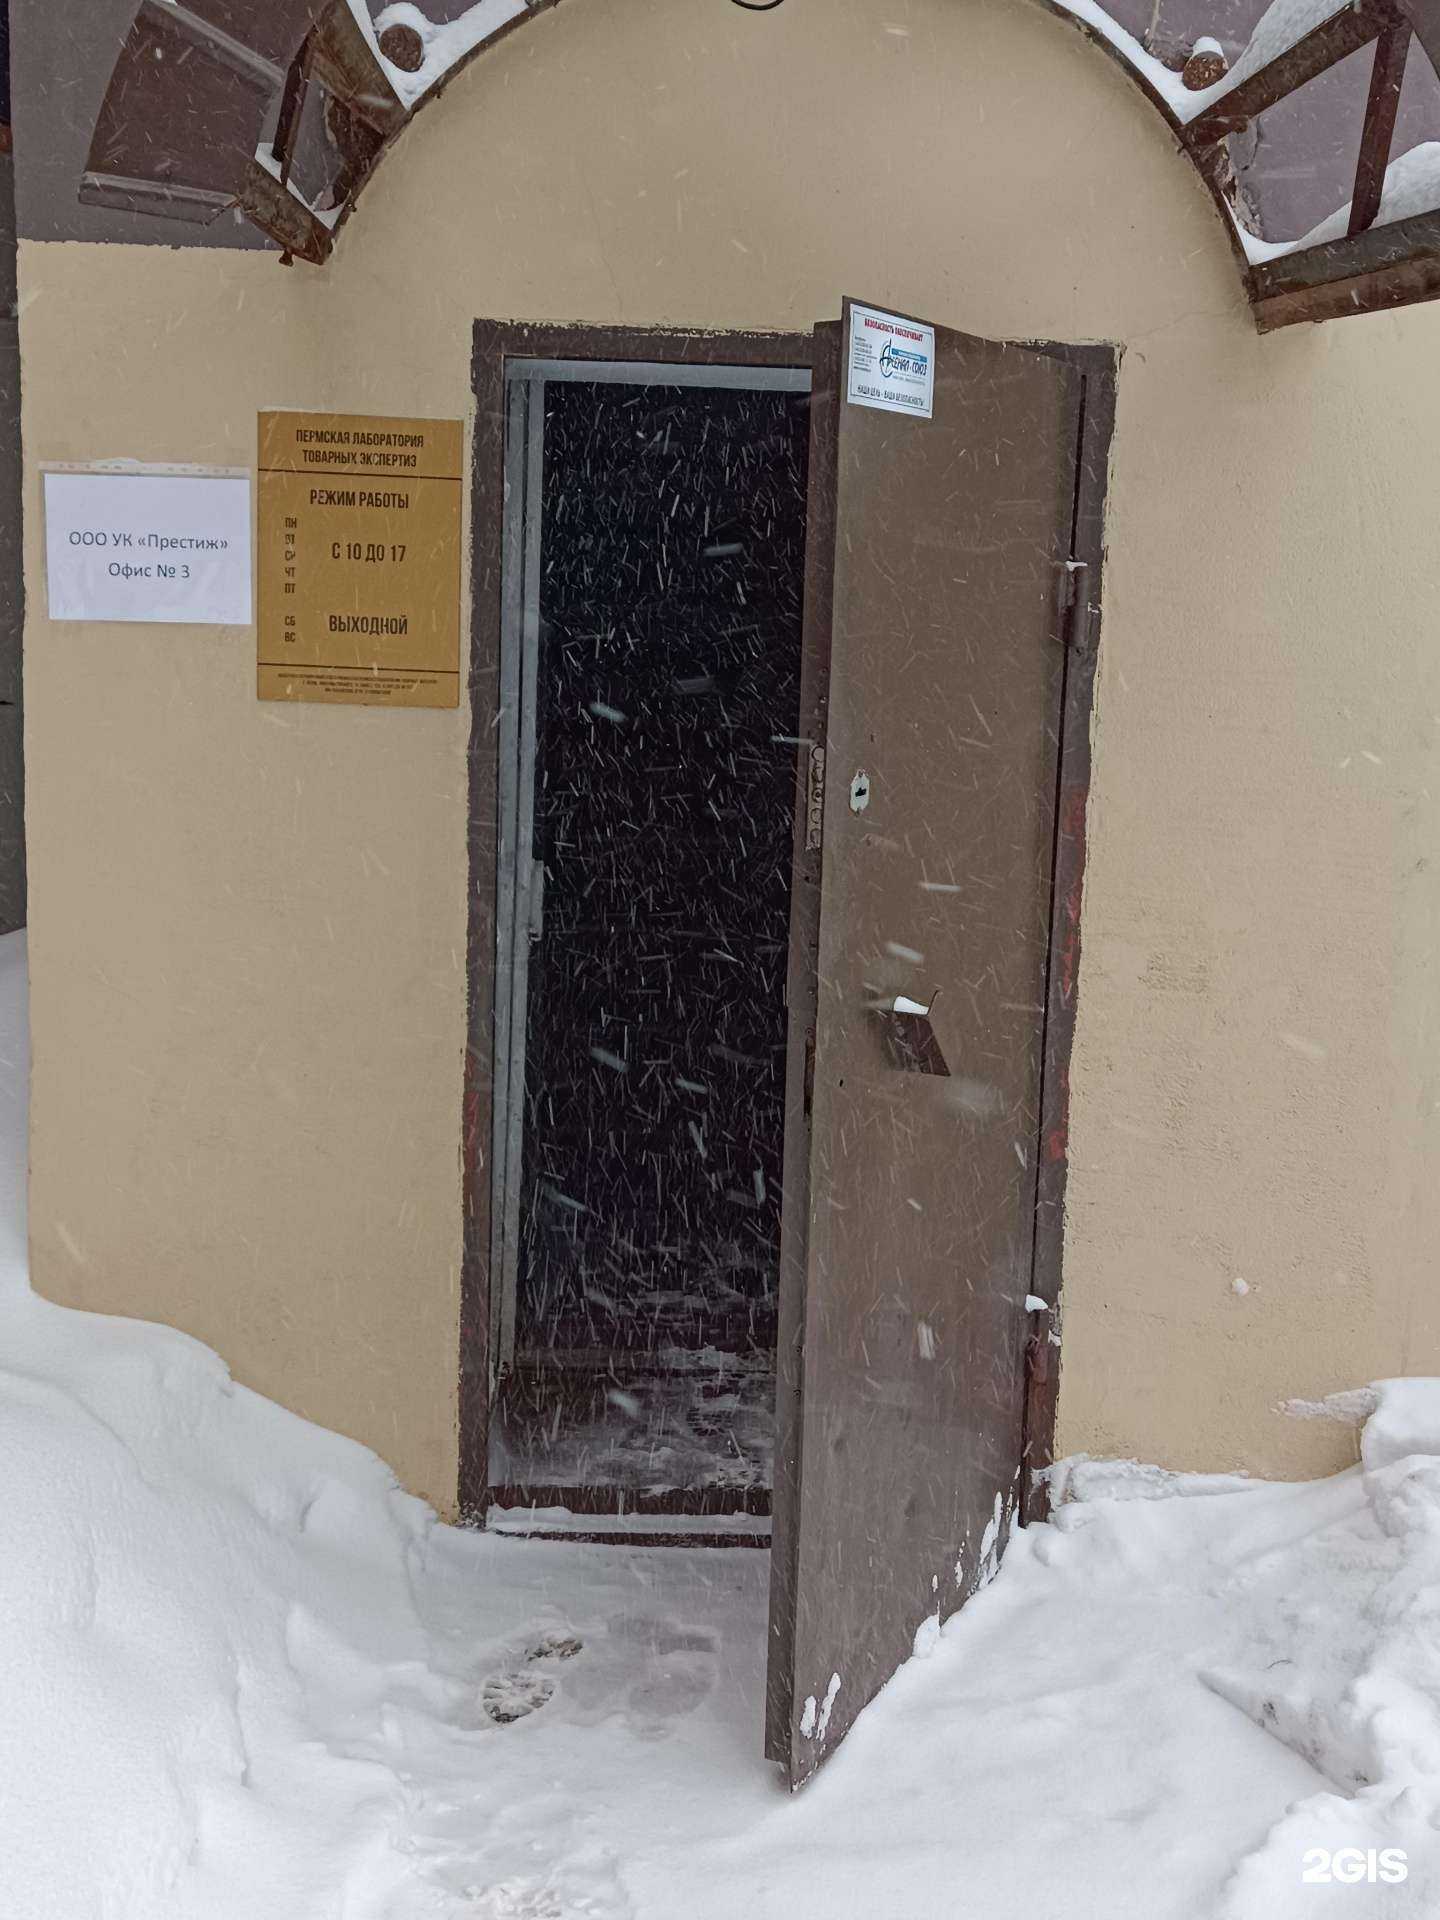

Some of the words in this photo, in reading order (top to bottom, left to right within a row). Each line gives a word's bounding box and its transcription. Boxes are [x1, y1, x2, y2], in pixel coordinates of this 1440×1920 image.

[296, 429, 350, 444] ПЕРМСКАЯ
[352, 432, 424, 448] ЛАБОРАТОРИЯ
[303, 449, 357, 465] ТОВАРНЫХ
[360, 453, 417, 467] ЭКСПЕРТИЗ
[310, 489, 356, 507] РЕЖИМ
[359, 491, 409, 509] РАБОТЫ
[285, 517, 297, 529] ПН
[69, 531, 108, 547] ООО
[112, 533, 133, 547] УК
[138, 534, 228, 551] «Престиж»
[332, 542, 341, 560] С
[347, 543, 362, 560] 10
[365, 544, 385, 563] ДО
[391, 545, 406, 562] 17
[108, 562, 152, 579] Офис
[157, 564, 176, 578] №
[181, 565, 190, 578] 3
[285, 567, 296, 578] ЧТ
[285, 583, 296, 594] ПТ
[285, 615, 296, 627] СБ
[329, 614, 408, 635] ВЫХОДНОЙ
[284, 632, 296, 643] ВС
